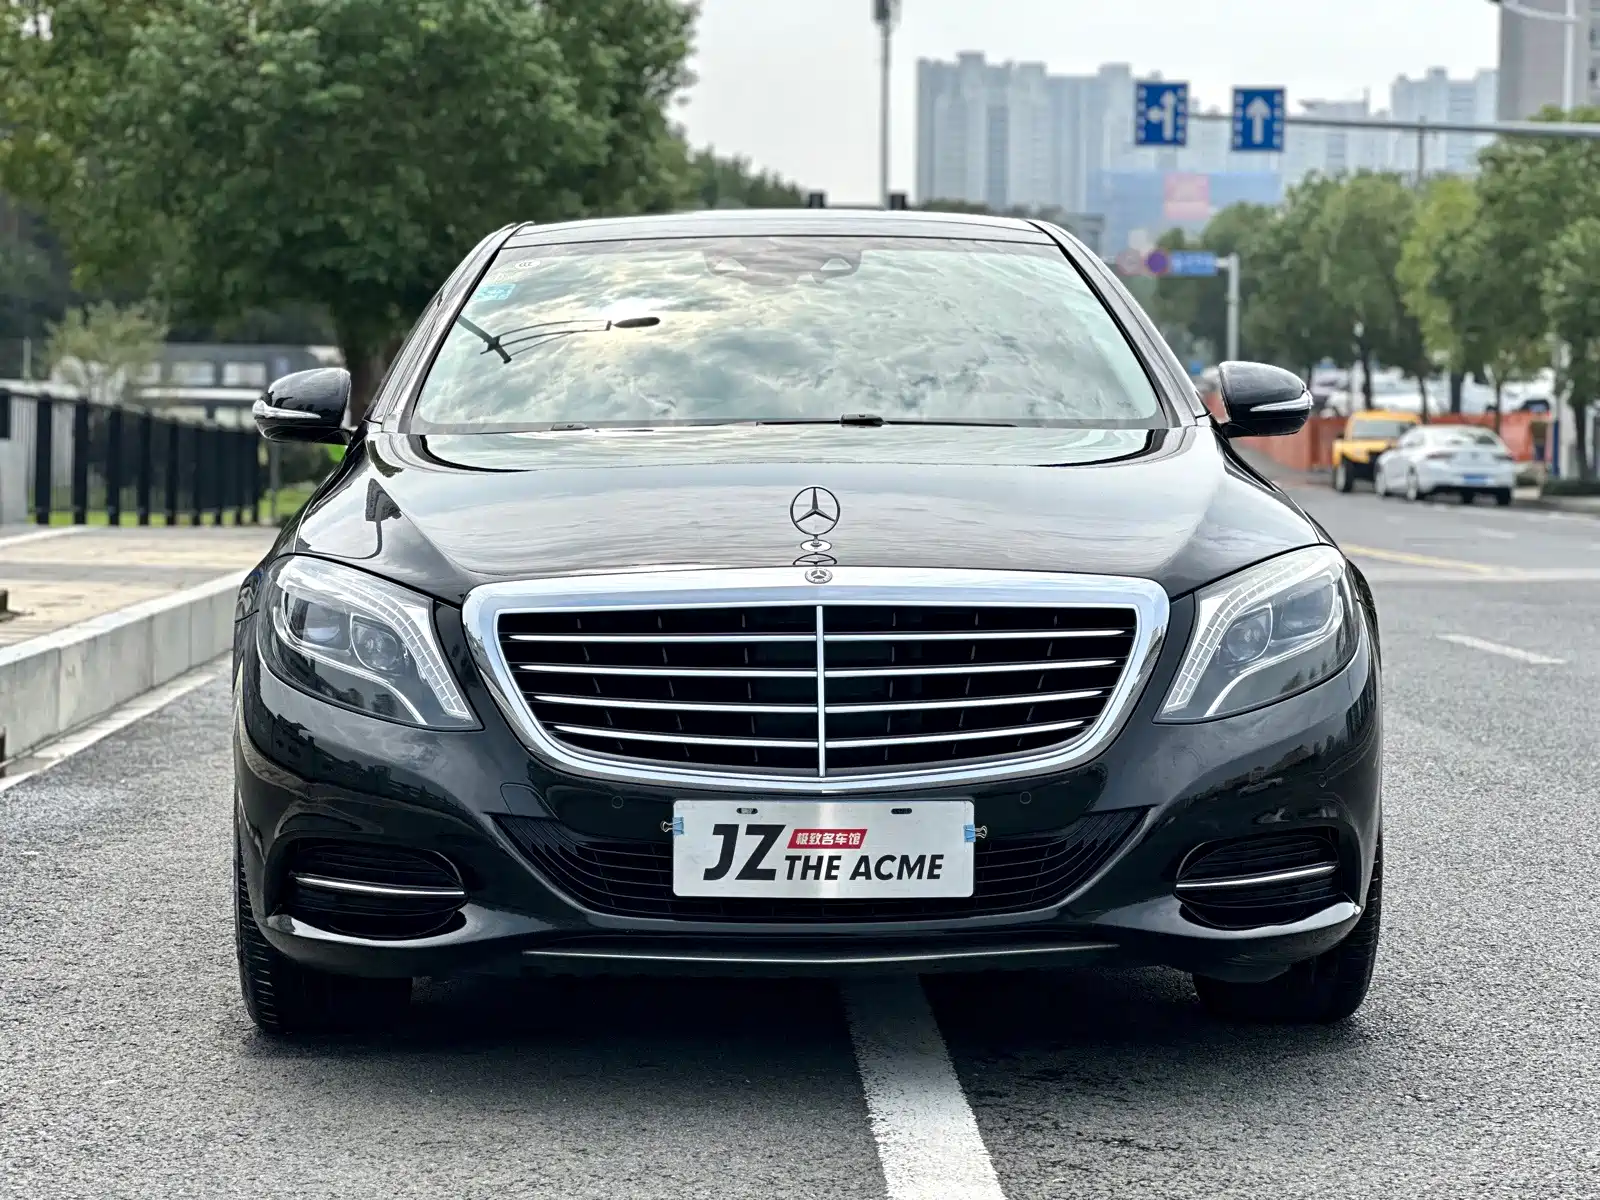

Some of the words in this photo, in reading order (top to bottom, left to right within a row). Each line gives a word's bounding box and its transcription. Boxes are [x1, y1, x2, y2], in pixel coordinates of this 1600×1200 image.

[703, 824, 786, 881] JZ
[796, 832, 861, 846] 极致名车馆
[785, 855, 842, 881] THE
[849, 854, 945, 881] ACME
